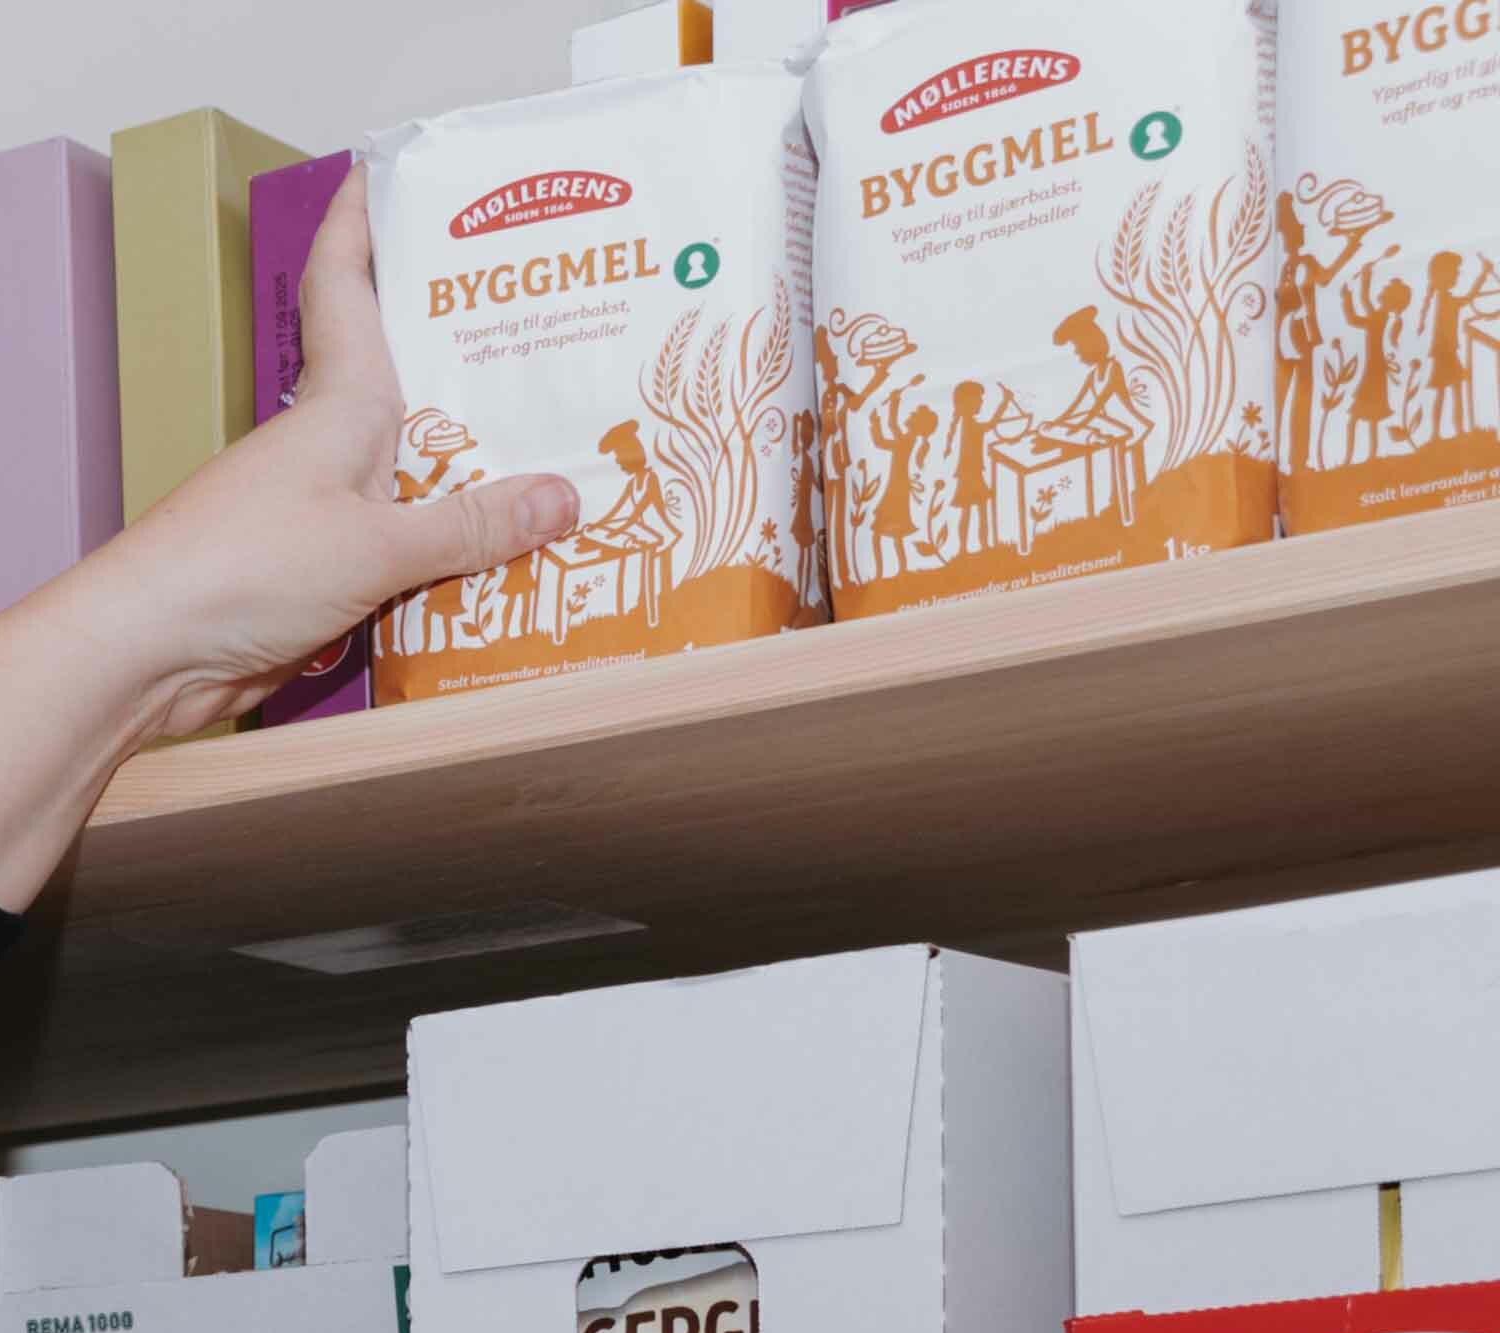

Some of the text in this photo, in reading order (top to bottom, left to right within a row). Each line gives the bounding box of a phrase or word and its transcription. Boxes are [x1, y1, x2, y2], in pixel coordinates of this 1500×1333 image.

[1341, 0, 1500, 77] BYGG
[893, 56, 1069, 127] MØLLERENS
[940, 83, 1017, 114] SIDEN 1866
[860, 111, 1113, 219] BYGGMEL
[461, 176, 623, 233] MØLLERENS
[504, 202, 574, 225] SIDEN 1866
[891, 180, 1082, 245] Ypperlig til gjærbakst,
[900, 203, 1079, 264] vafler og raspeballer
[428, 238, 660, 319] BYGGMEL
[453, 300, 630, 345] Ypperlig til gjærbakst,
[461, 324, 628, 364] vafler og raspeballer
[438, 675, 469, 691] Stolt
[544, 663, 560, 676] av
[88, 1311, 134, 1333] 1000
